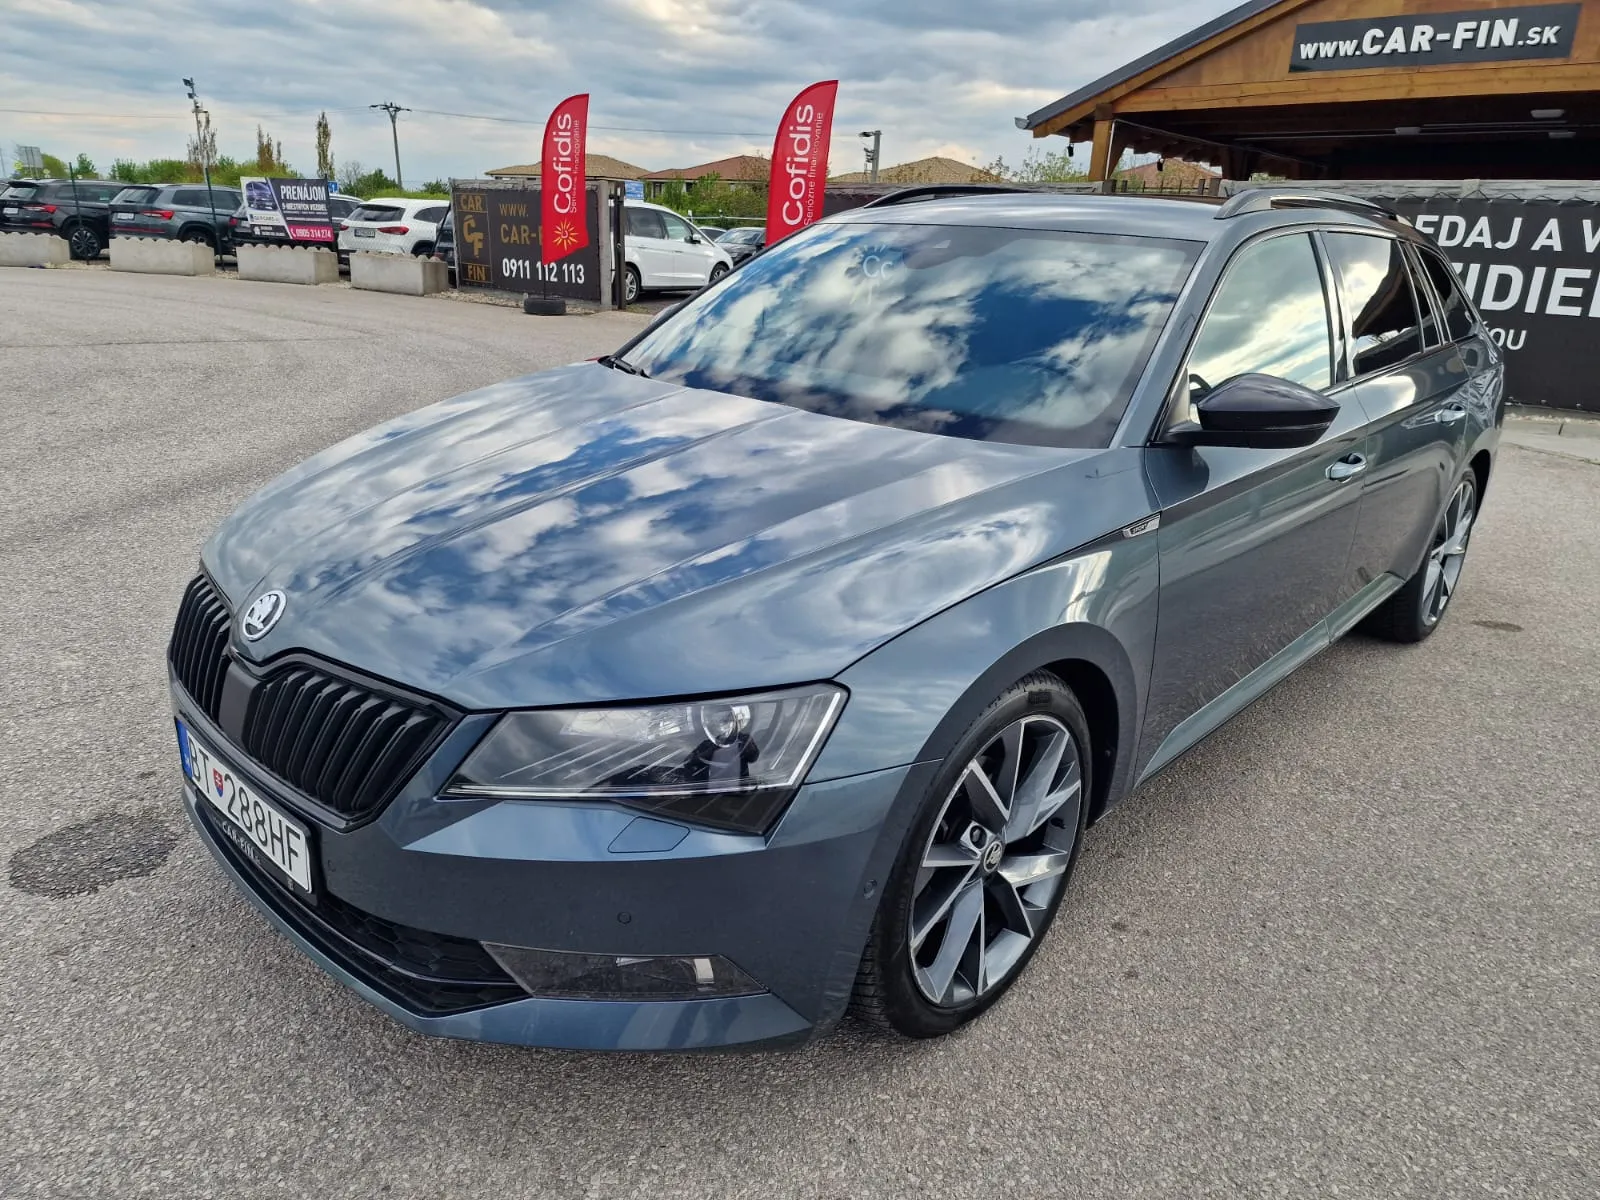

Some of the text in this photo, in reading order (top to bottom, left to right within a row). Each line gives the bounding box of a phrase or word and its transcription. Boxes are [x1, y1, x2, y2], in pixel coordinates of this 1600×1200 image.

[553, 113, 572, 214] Cofidis
[782, 104, 814, 226] Cofidis
[280, 183, 326, 201] PRENÁJOM
[460, 195, 483, 211] CAR
[500, 223, 542, 246] CAR-
[1530, 218, 1563, 252] A
[467, 264, 486, 281] FIN
[502, 257, 585, 285] 0911 112 113
[1451, 262, 1600, 318] IDIE
[1483, 321, 1527, 351] OU
[188, 735, 300, 872] BT 288HF
